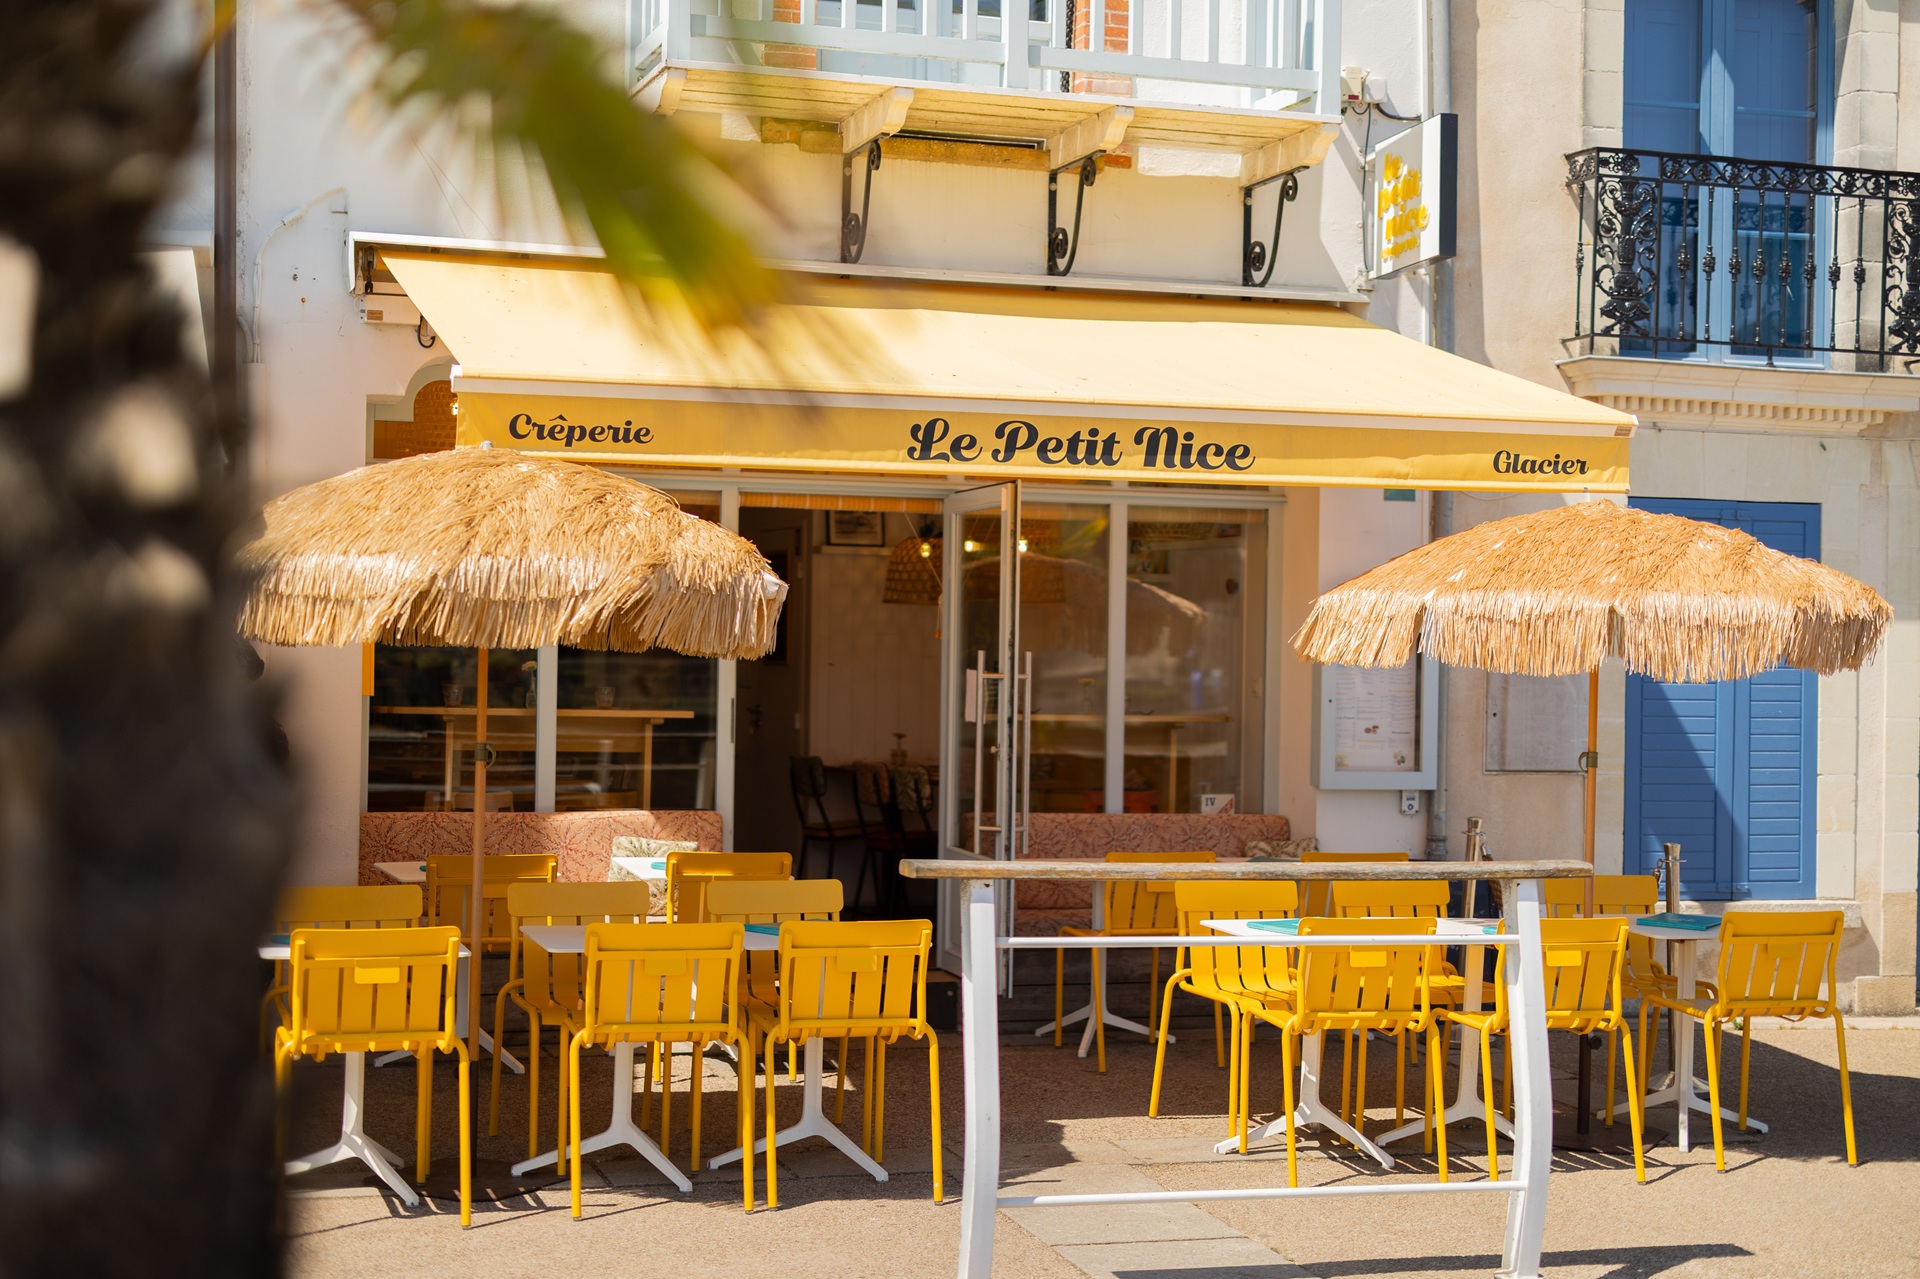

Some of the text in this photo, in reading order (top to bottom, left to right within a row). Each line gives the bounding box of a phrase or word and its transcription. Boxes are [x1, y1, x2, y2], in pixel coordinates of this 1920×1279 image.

[1384, 153, 1403, 183] le
[1378, 168, 1422, 220] petit
[1385, 203, 1429, 242] nice
[509, 413, 654, 447] Crêperie
[907, 417, 1256, 472] Le Petit Nice
[1493, 450, 1589, 475] Glacier
[1204, 797, 1217, 807] IV
